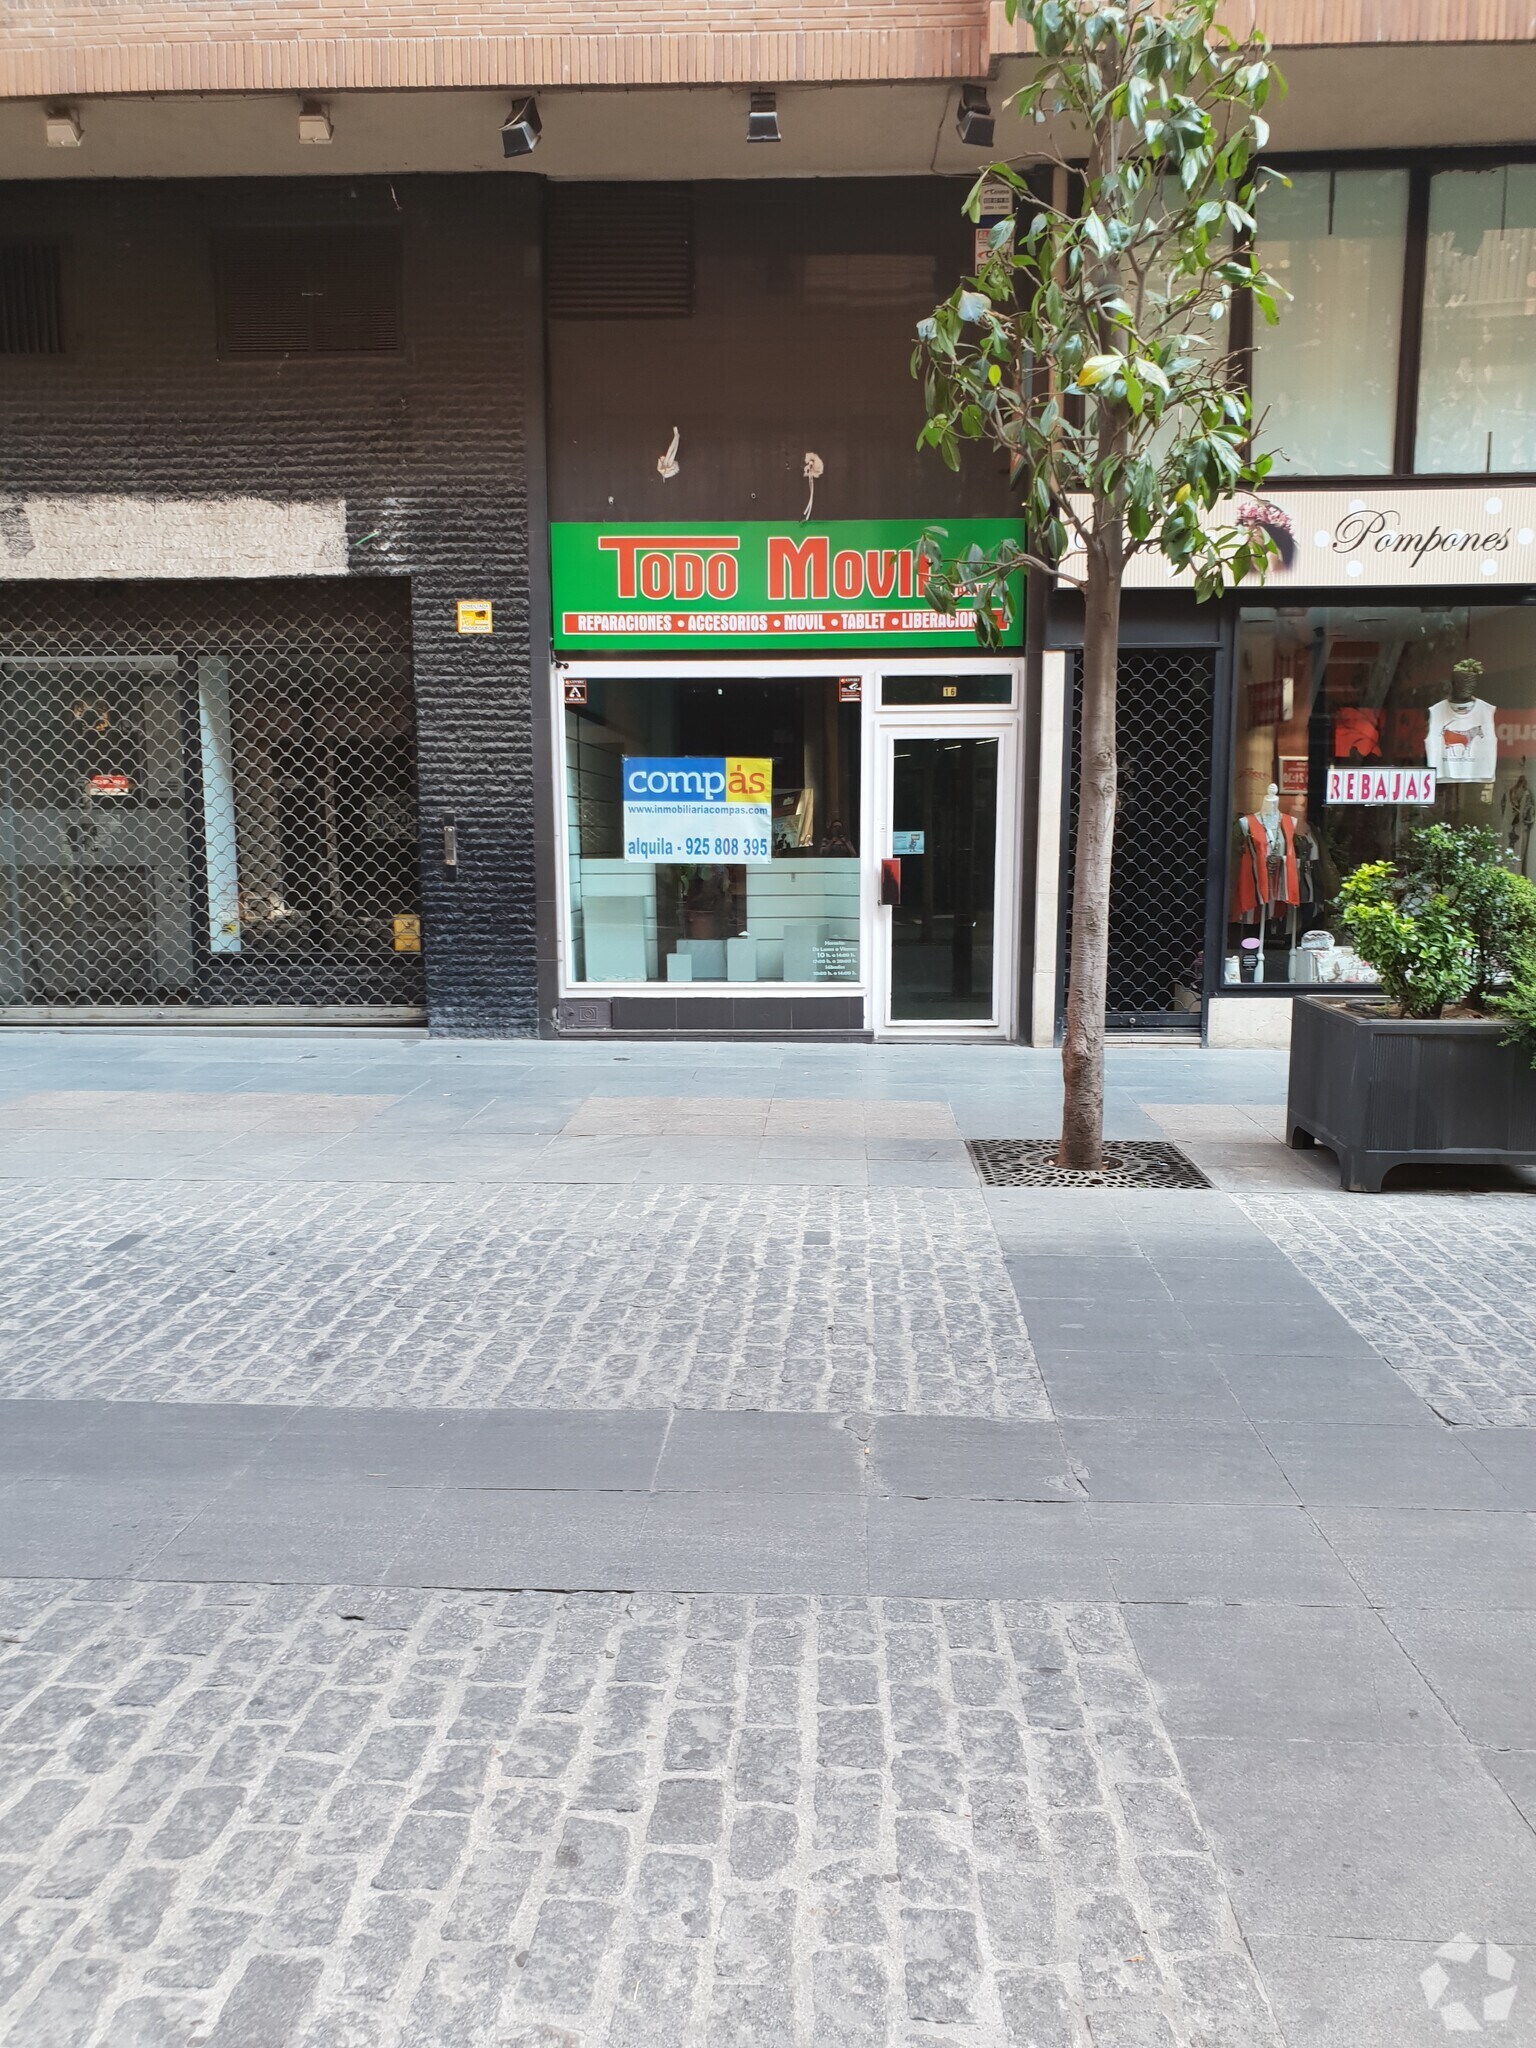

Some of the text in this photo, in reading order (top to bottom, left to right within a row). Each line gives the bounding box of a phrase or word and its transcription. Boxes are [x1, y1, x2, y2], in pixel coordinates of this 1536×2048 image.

[1332, 509, 1512, 569] Pompones
[598, 536, 740, 601] TODO
[577, 610, 979, 632] REPARACIONES ACCESORIOS MOVIL TABLET LIBERACION
[944, 688, 956, 697] 16
[628, 765, 767, 801] compás
[1329, 772, 1432, 801] REBAJAS
[628, 804, 769, 817] www.inmobiliariacompas.com
[628, 837, 673, 860] alquila
[685, 837, 710, 856] 925
[714, 837, 739, 856] 808
[743, 837, 768, 856] 395
